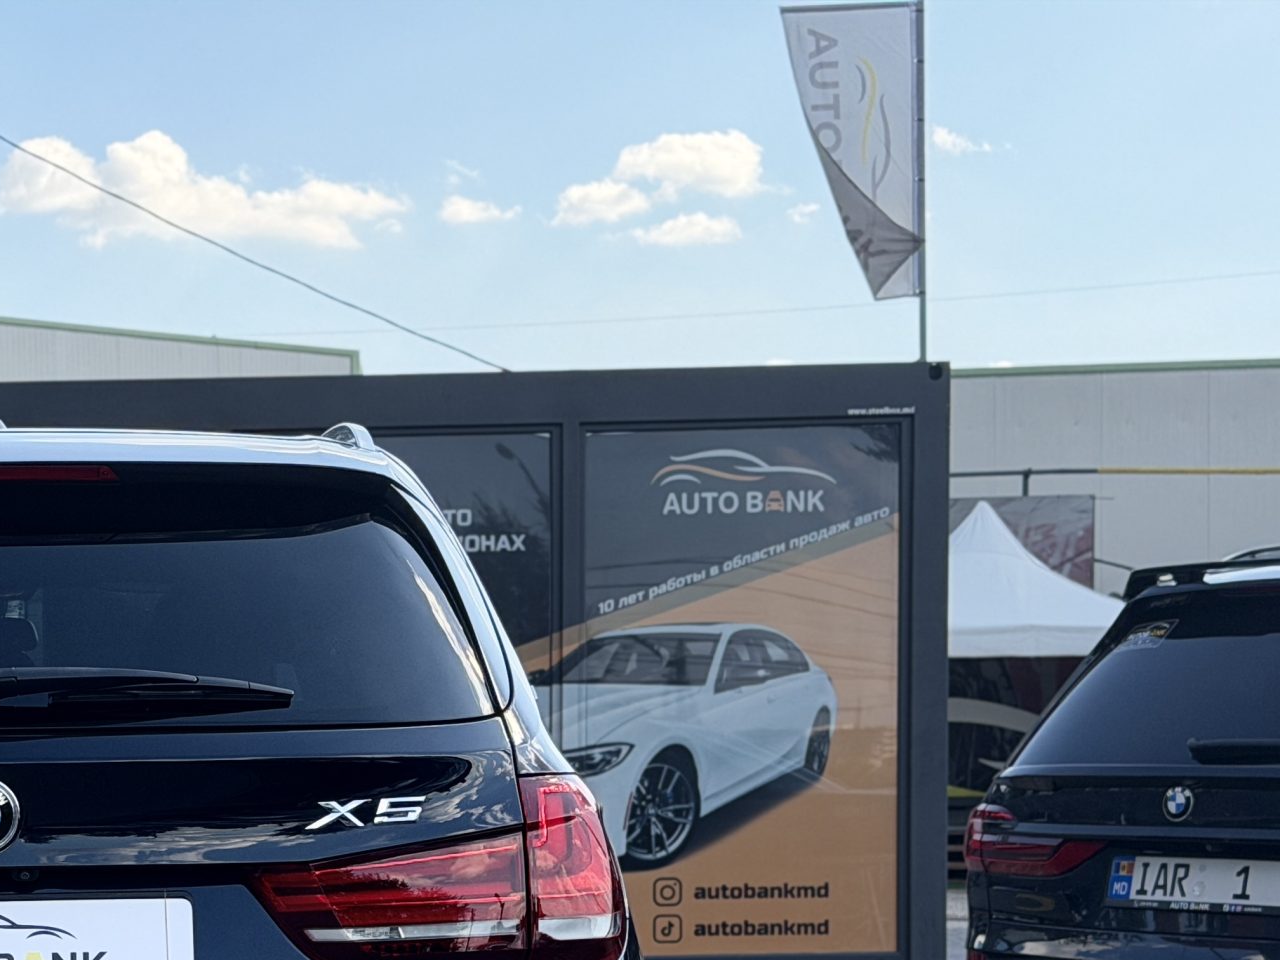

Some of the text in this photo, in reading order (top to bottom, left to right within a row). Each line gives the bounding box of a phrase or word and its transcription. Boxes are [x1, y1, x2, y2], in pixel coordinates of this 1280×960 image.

[807, 28, 843, 166] AUTO
[662, 492, 739, 515] AUTO
[460, 533, 526, 552] ОНАХ
[597, 506, 890, 615] 10 лет работы в области продаж авто
[304, 796, 426, 829] X5
[694, 882, 829, 899] autobankmd
[1112, 881, 1128, 895] MD
[1135, 862, 1191, 897] IAR
[694, 919, 829, 937] autobankmd
